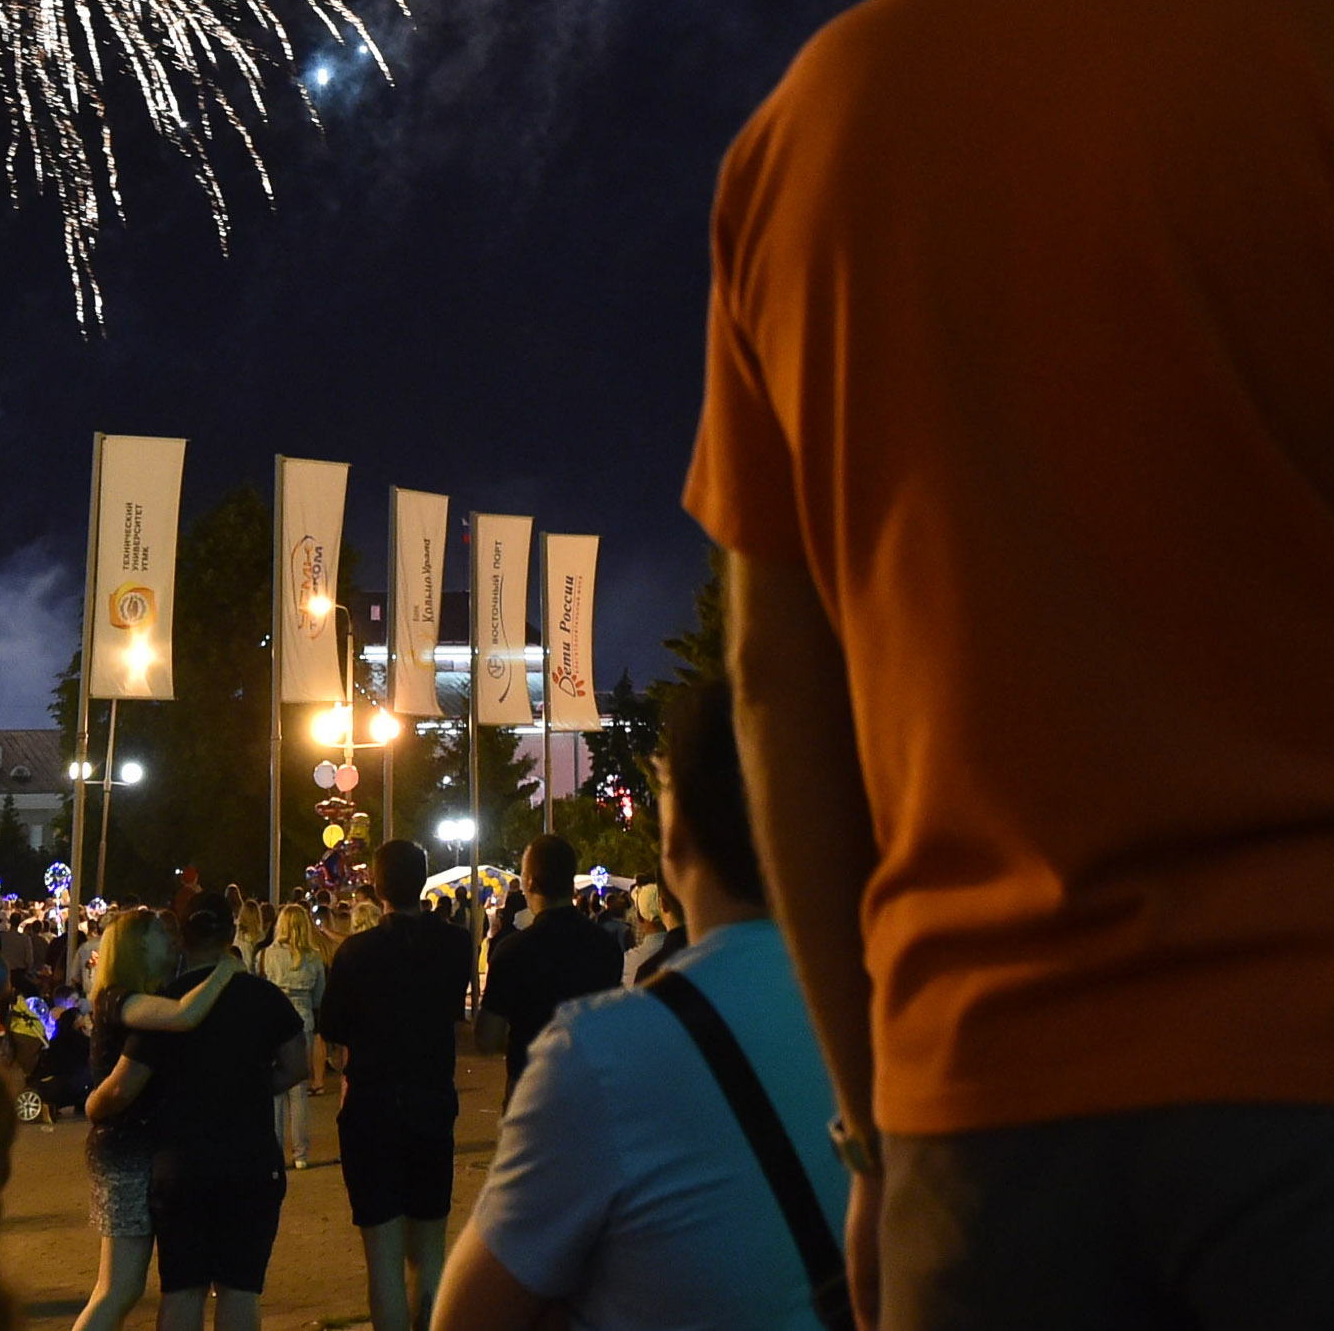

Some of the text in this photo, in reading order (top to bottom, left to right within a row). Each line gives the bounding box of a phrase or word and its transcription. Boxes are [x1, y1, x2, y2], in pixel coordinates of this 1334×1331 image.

[122, 502, 134, 571] ТЕХНИЧЕСКИЙ
[132, 505, 143, 572] УНИВЕРСИТЕТ
[141, 546, 149, 572] УГМК
[422, 577, 434, 623] Кольцо
[491, 540, 501, 645] ВОСТОЧНЫЙ ПОРТ
[558, 575, 576, 698] Дети России
